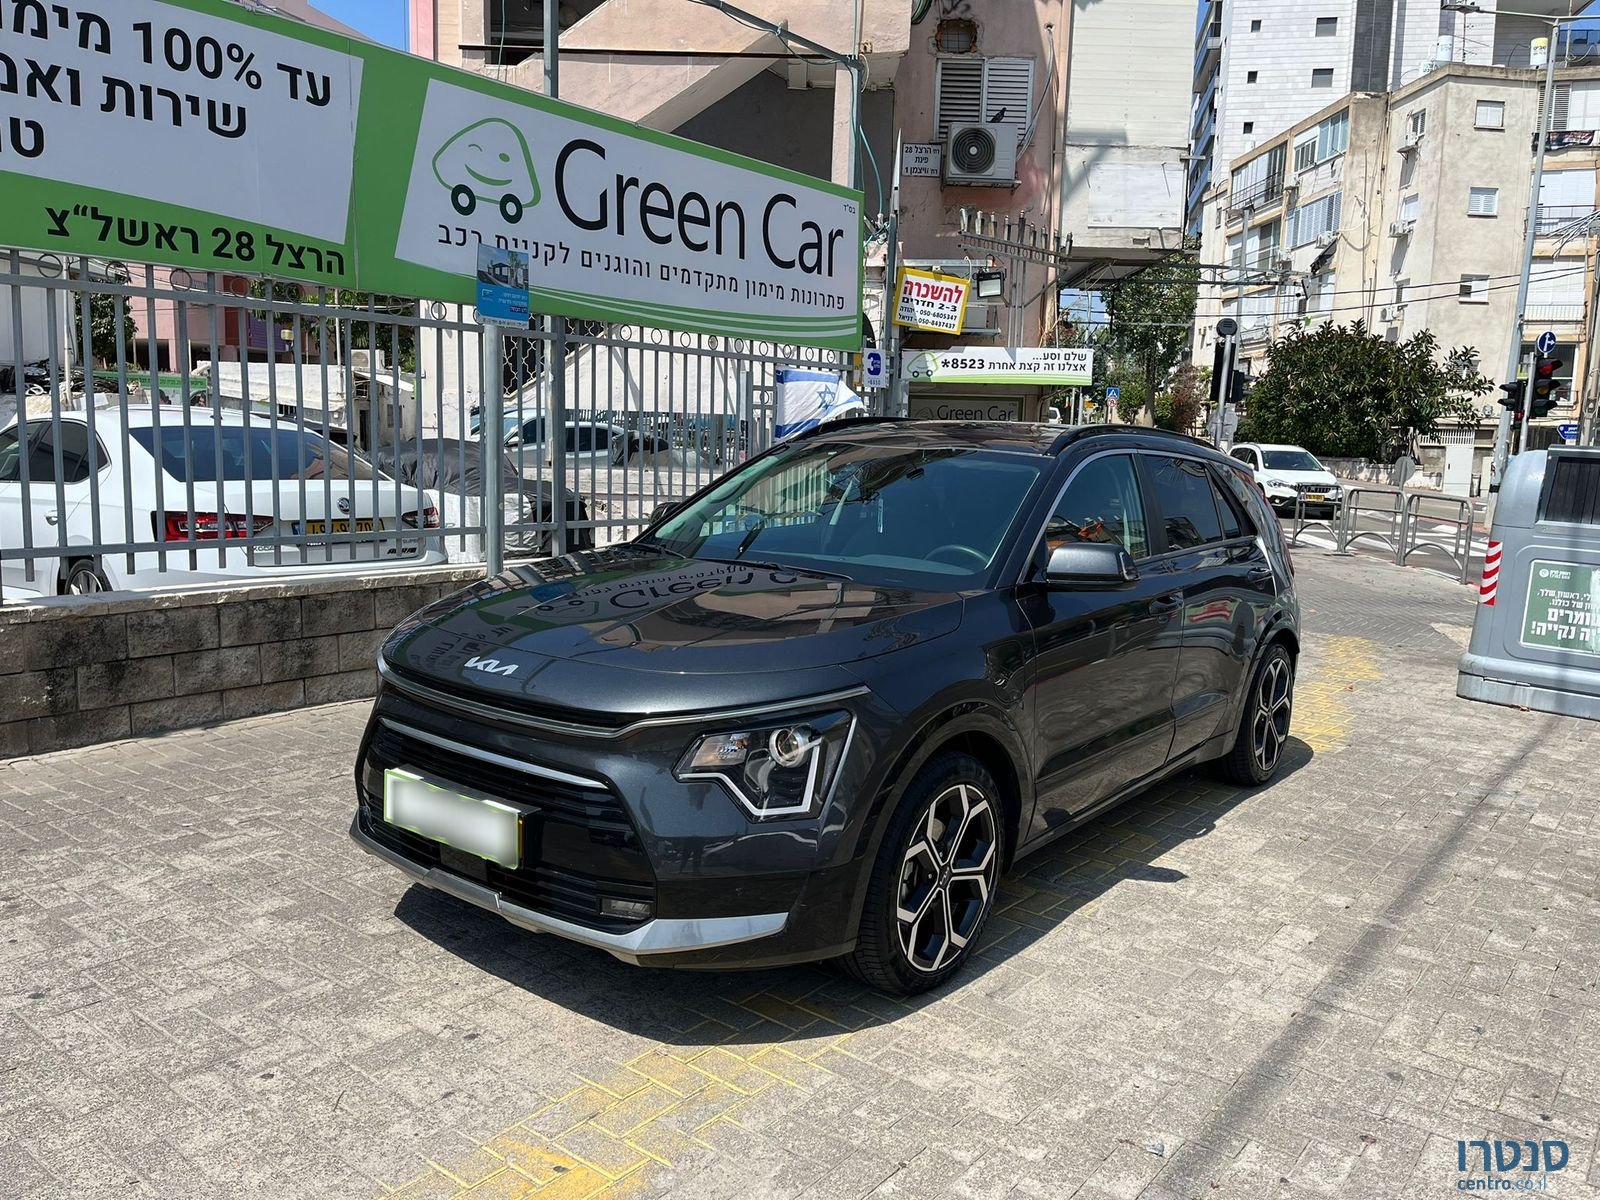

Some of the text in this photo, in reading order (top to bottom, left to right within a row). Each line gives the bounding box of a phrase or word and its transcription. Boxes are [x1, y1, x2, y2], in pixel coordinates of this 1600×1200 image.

[0, 0, 331, 107] עד 100% מימ
[100, 76, 247, 138] שירות
[0, 116, 44, 158] ט
[914, 145, 932, 154] הרצל
[914, 156, 929, 164] פינת
[555, 138, 844, 277] Green Car
[211, 226, 256, 262] 28
[265, 233, 345, 275] הרצל
[580, 250, 651, 278] והוגנים
[660, 264, 738, 292] מתקדמים
[746, 279, 785, 300] מימון
[791, 286, 845, 310] פתרונות
[903, 280, 963, 304] להשכרה
[901, 296, 958, 313] 2-3 חדרים
[988, 361, 1087, 373] אצלנו זה קצת אחרת
[1032, 351, 1087, 361] שלם וסע...
[936, 404, 1014, 420] Green Car
[1531, 620, 1576, 641] נקייה!
